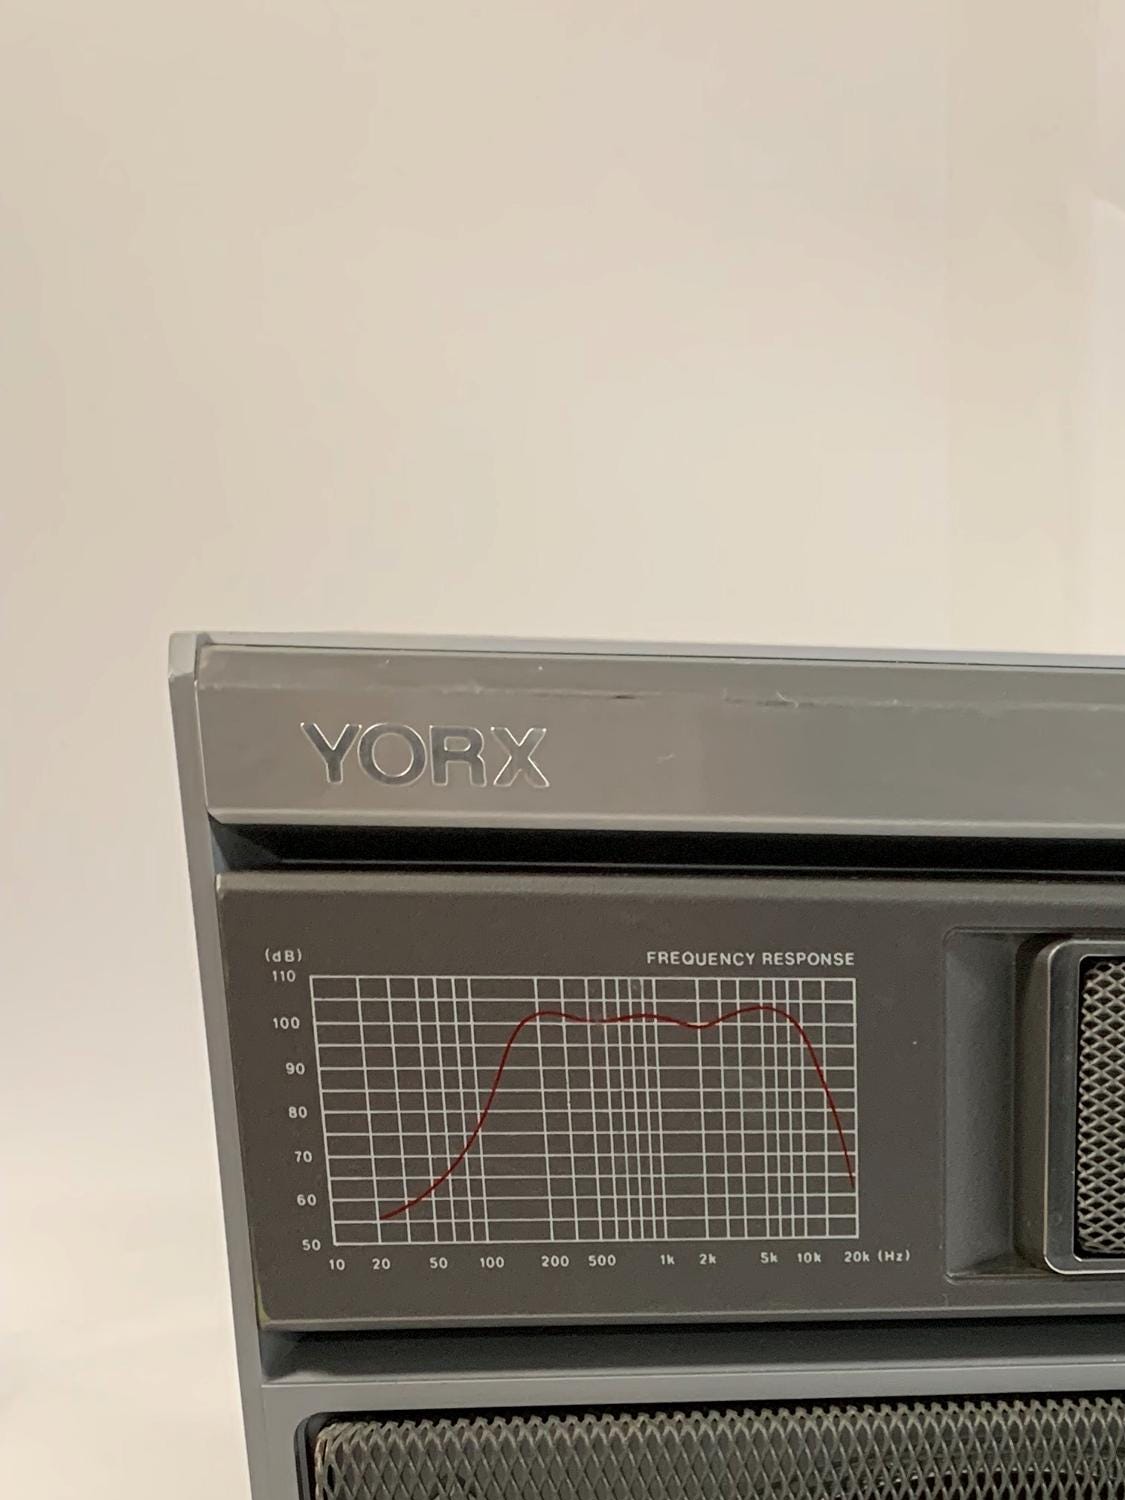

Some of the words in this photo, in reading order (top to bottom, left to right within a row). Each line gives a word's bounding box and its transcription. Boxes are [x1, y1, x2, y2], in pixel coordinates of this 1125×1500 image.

[299, 721, 551, 789] YORX
[264, 948, 302, 963] (dB)
[646, 950, 756, 967] FREQUENCY
[762, 951, 855, 967] RESPONSE
[272, 969, 296, 983] 110
[272, 1016, 300, 1030] 100
[285, 1062, 306, 1075] 90
[288, 1105, 308, 1119] 80
[294, 1150, 313, 1163] 70
[296, 1193, 317, 1206] 60
[302, 1238, 321, 1251] 50
[329, 1258, 346, 1271] 10
[372, 1257, 391, 1270] 20
[429, 1256, 448, 1269] 50
[479, 1256, 505, 1269] 100
[541, 1255, 570, 1268] 200
[588, 1254, 617, 1267] 500
[660, 1254, 675, 1265] 1k
[699, 1253, 717, 1265] 2k
[760, 1251, 778, 1264] 5k
[797, 1251, 822, 1264] 10k
[844, 1250, 870, 1263] 20k
[877, 1249, 911, 1262] (Hz)
